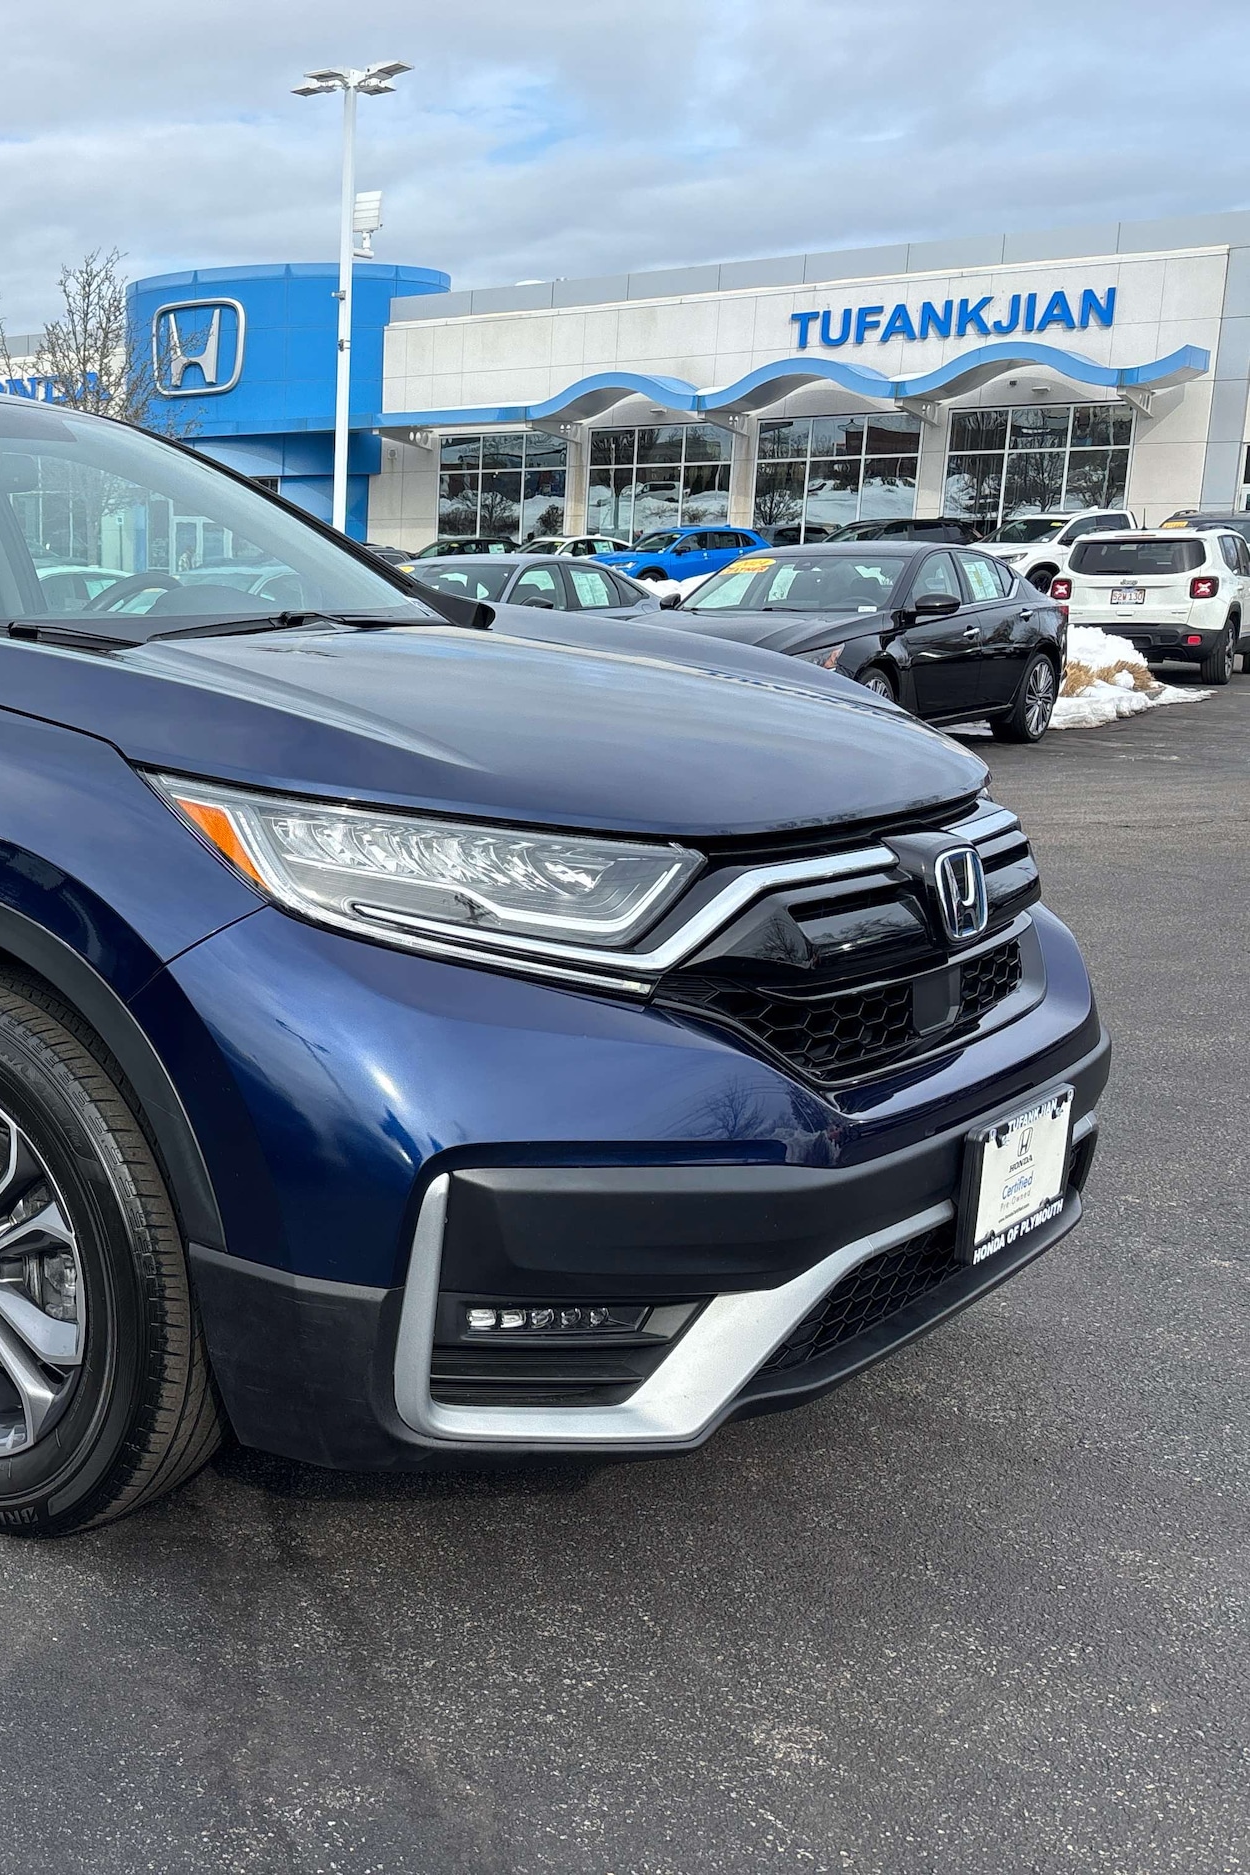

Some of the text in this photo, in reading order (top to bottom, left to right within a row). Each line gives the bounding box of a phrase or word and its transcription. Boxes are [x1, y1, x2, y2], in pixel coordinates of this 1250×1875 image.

[791, 286, 1117, 349] TUFANKJIAN
[1007, 1097, 1058, 1133] TUFANKJIAN
[1008, 1156, 1033, 1173] HONDA
[1001, 1170, 1034, 1200] Certified
[972, 1236, 1005, 1265] HONDA
[1007, 1226, 1020, 1244] OF
[1020, 1198, 1064, 1236] PLYMOUTH
